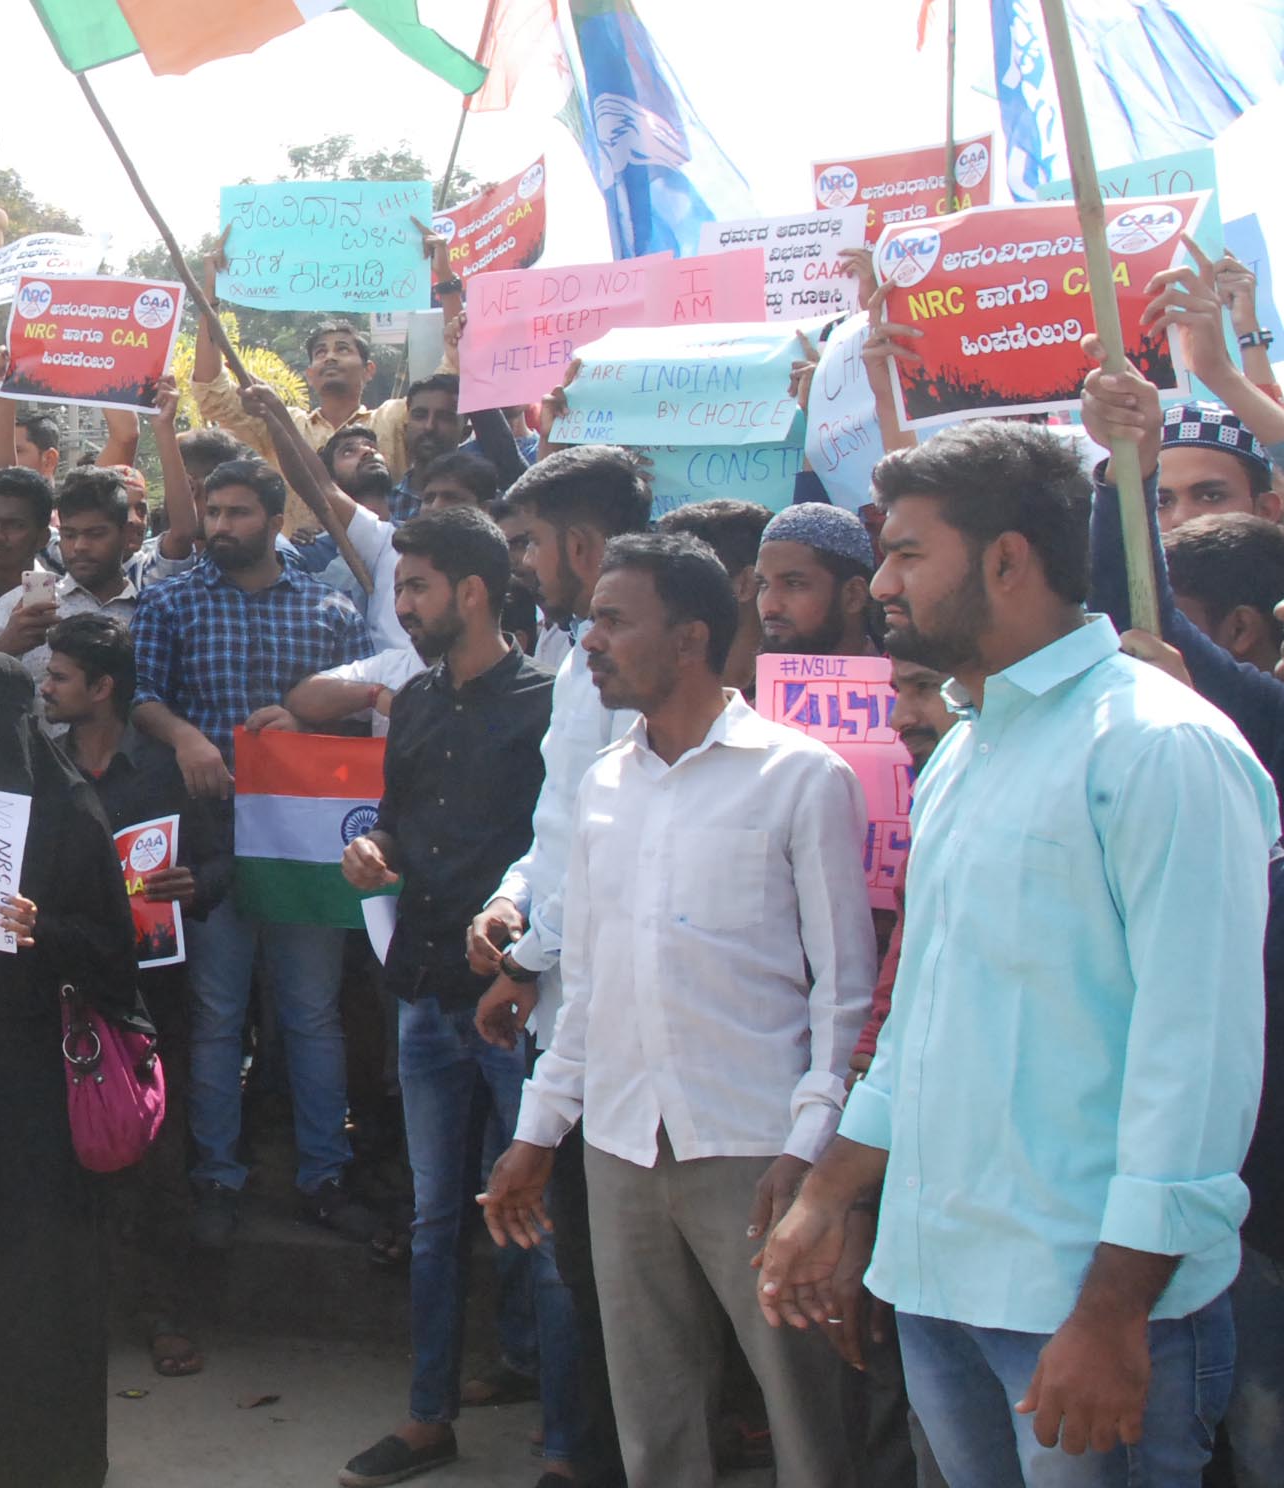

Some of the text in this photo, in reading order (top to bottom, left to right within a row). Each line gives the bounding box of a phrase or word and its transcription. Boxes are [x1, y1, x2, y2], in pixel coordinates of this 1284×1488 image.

[959, 148, 986, 166] CAA
[820, 172, 855, 192] NRC
[449, 243, 470, 261] RC
[507, 202, 533, 226] CAA
[1117, 211, 1174, 227] CAA
[885, 234, 938, 261] NRC
[481, 268, 645, 317] WE DO NOT
[679, 268, 713, 297] I
[908, 262, 1131, 321] NRC ಹಾಗೂ CA
[140, 295, 170, 308] CAA
[673, 295, 712, 321] AM
[24, 323, 57, 339] NRC
[111, 329, 148, 348] CAA
[533, 307, 609, 340] ACCEPT
[961, 317, 1082, 357] ಹಿಂಪಡೆಯಿರಿ
[492, 340, 573, 377] HITLER
[592, 364, 628, 381] ARE
[632, 364, 742, 394] INDIAN
[657, 399, 788, 428] BY CHOICE
[556, 426, 614, 441] NO NRC
[780, 657, 847, 677] #NSUI
